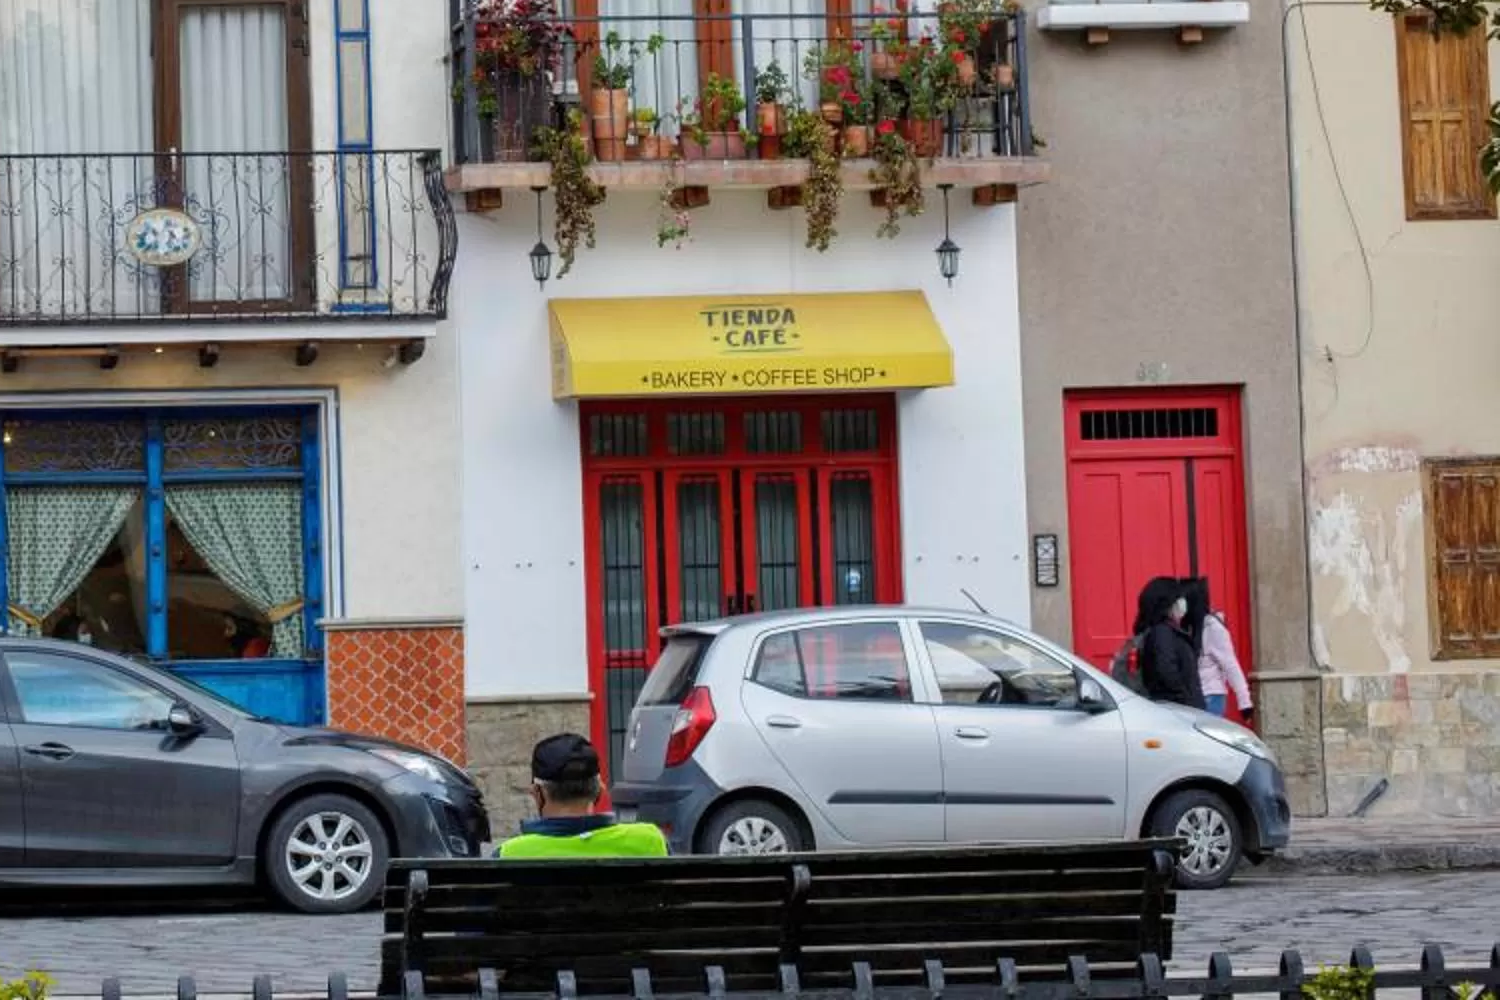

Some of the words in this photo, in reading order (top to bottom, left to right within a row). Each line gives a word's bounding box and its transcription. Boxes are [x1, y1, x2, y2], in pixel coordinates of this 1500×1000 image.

[699, 307, 795, 327] TIENDA
[651, 371, 727, 389] BAKERY
[743, 368, 818, 387] COFFEE
[823, 367, 875, 385] SHOP
